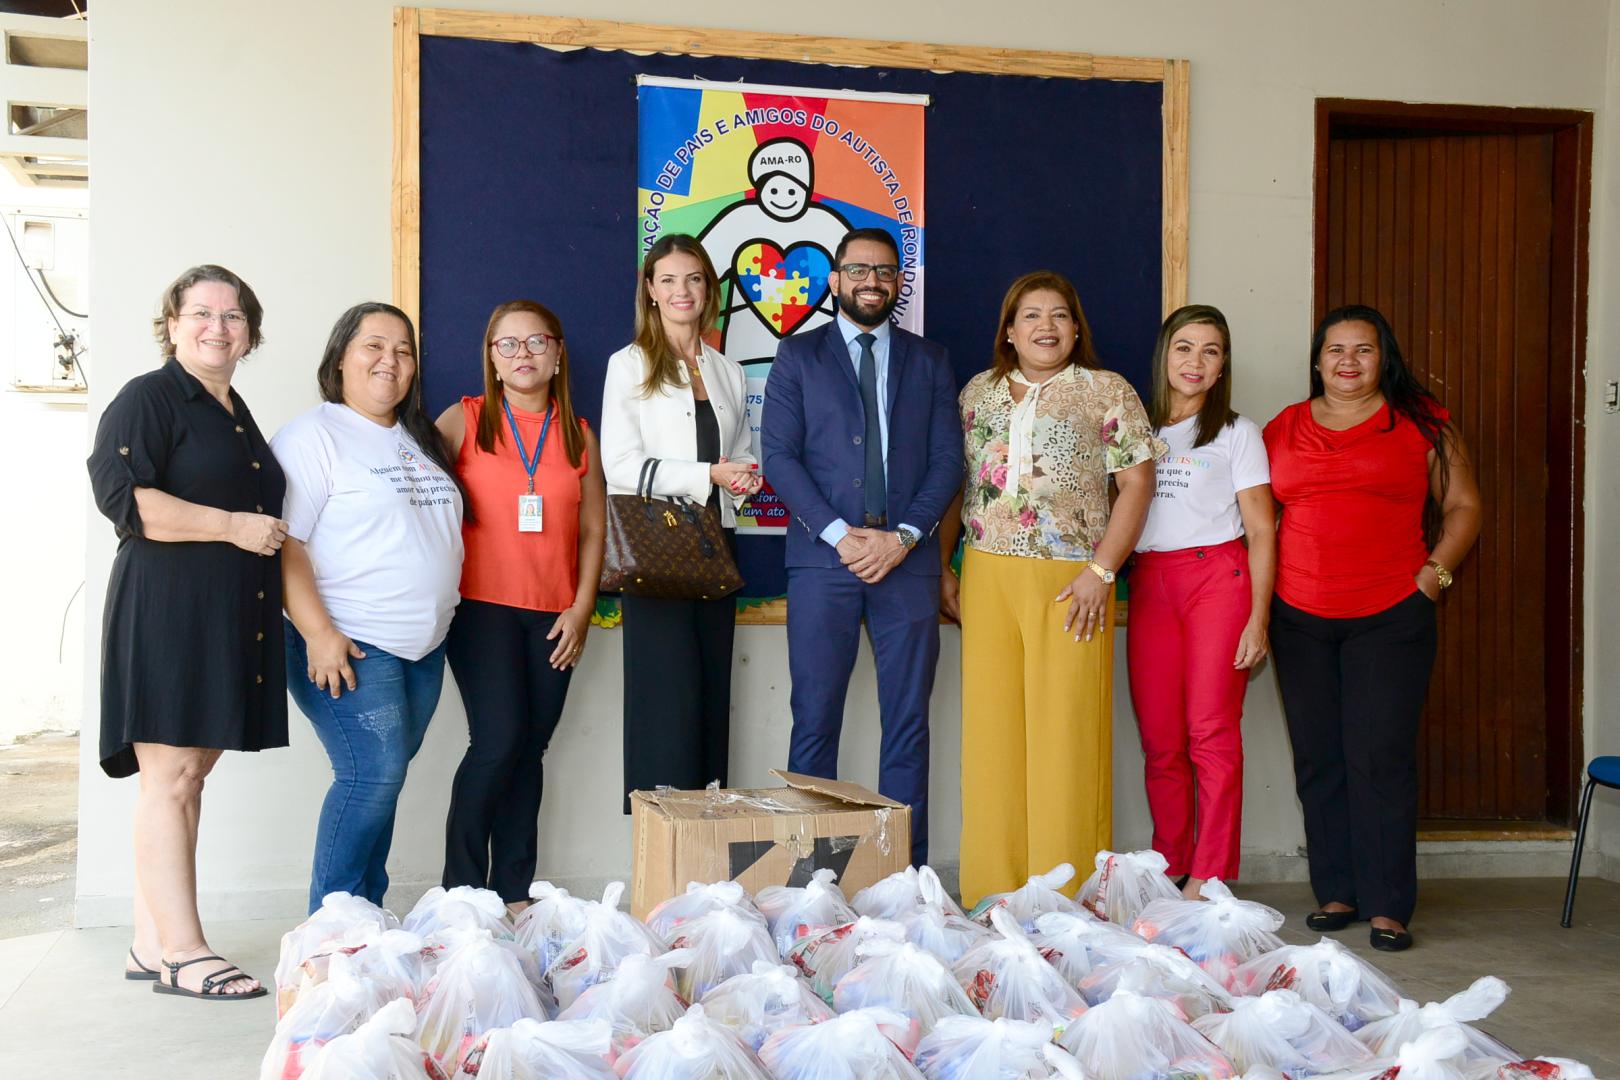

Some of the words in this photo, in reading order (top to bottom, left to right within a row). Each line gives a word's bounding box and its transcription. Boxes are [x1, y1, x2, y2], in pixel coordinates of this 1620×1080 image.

[656, 161, 681, 189] DE
[675, 128, 714, 163] PAIS
[714, 119, 730, 136] E
[733, 108, 806, 129] AMIGOS
[811, 115, 839, 135] DO
[840, 131, 900, 195] AUTISTA
[894, 197, 913, 223] DE
[760, 155, 802, 166] AMA-RO
[369, 464, 402, 475] Alguém
[1166, 468, 1183, 477] que
[1158, 479, 1189, 488] precisa
[743, 508, 763, 516] um
[766, 506, 785, 516] ato
